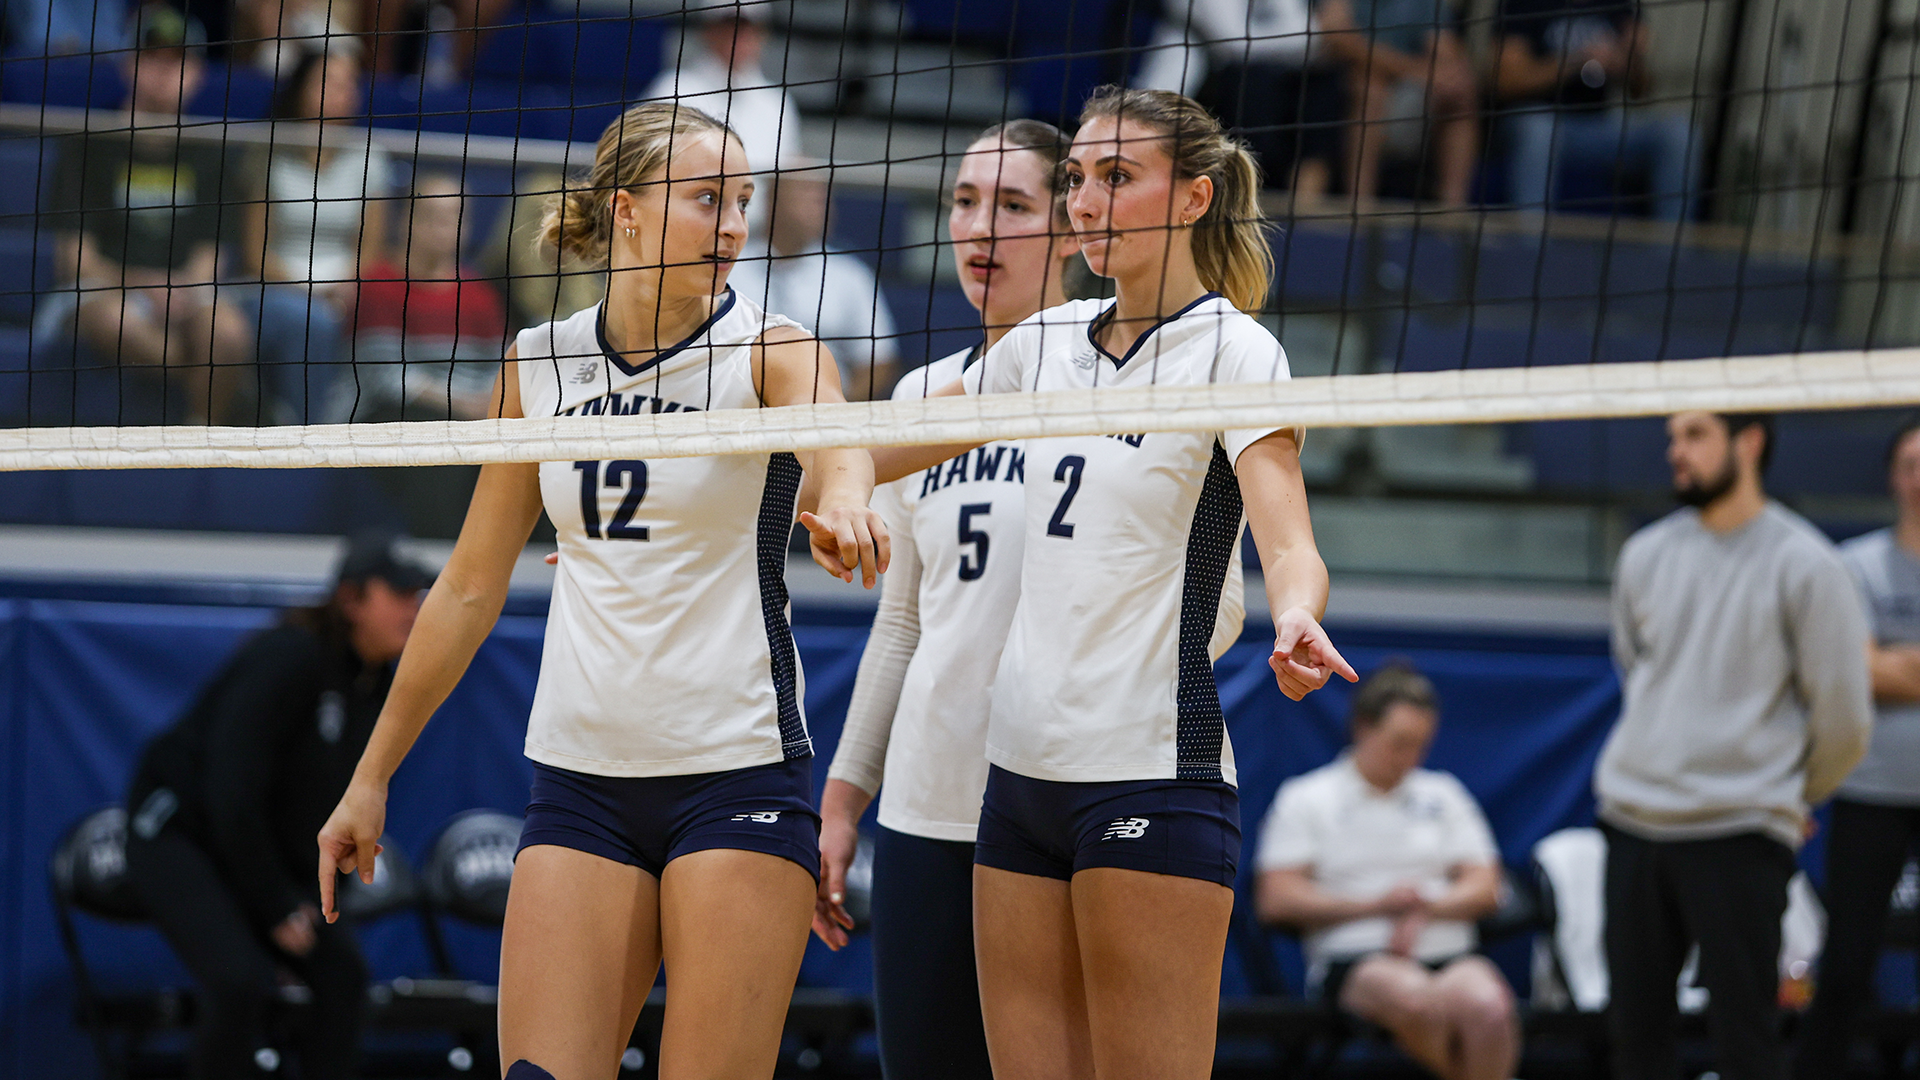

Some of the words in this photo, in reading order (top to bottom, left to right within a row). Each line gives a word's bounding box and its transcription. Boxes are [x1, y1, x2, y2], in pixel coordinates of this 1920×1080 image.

[573, 459, 650, 541] 12
[1046, 454, 1086, 539] 2
[958, 502, 992, 582] 5
